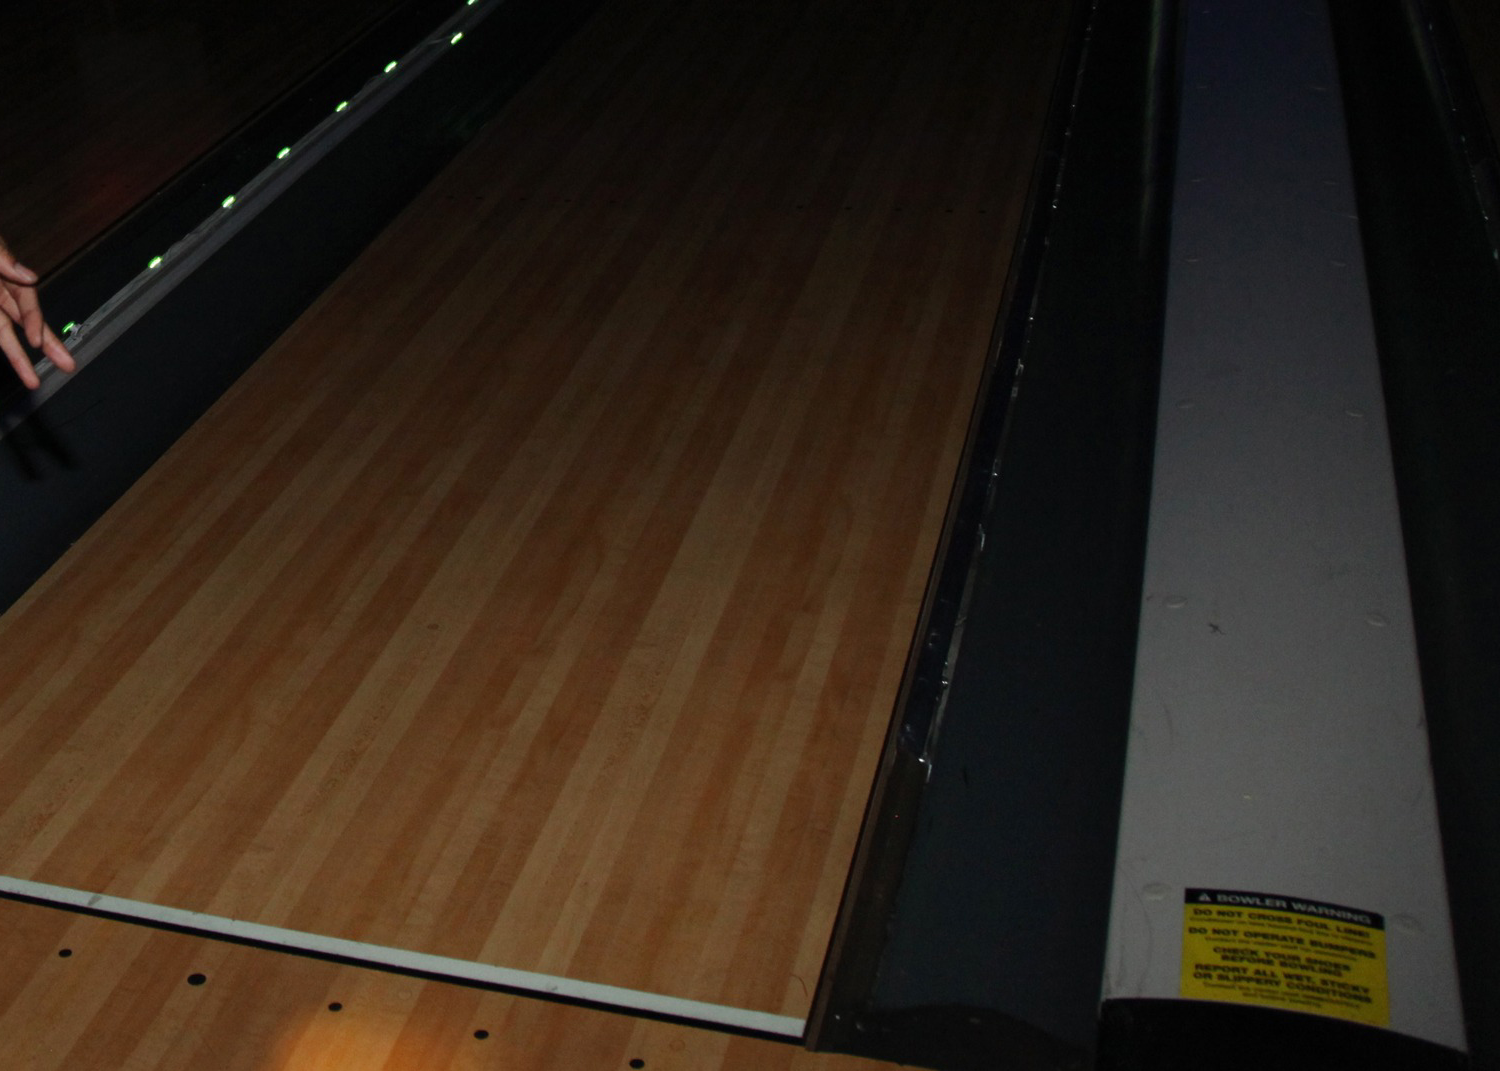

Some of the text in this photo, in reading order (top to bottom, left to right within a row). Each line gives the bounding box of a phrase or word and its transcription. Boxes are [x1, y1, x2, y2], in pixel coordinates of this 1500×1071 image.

[1193, 908, 1213, 916] DO
[1216, 910, 1242, 918] NOT
[1248, 912, 1292, 924] CROSS
[1297, 917, 1329, 929] FOUL
[1216, 893, 1372, 925] BOWLER WARNING
[1188, 926, 1208, 934] DO
[1212, 927, 1238, 936] NOT
[1243, 930, 1303, 945] OPERATE
[1309, 939, 1376, 959] BUMPERS
[1213, 946, 1259, 957] CHECK
[1263, 951, 1301, 961] YOUR
[1305, 956, 1351, 971] SHOES
[1221, 954, 1342, 977] BEFORE BOWLING
[1192, 971, 1213, 980] OR
[1217, 974, 1281, 987] SLIPPERY
[1285, 981, 1373, 1004] CONDITIONS
[1194, 963, 1248, 974] REPORT
[1253, 968, 1278, 978] ALL
[1320, 978, 1369, 994] STICKY
